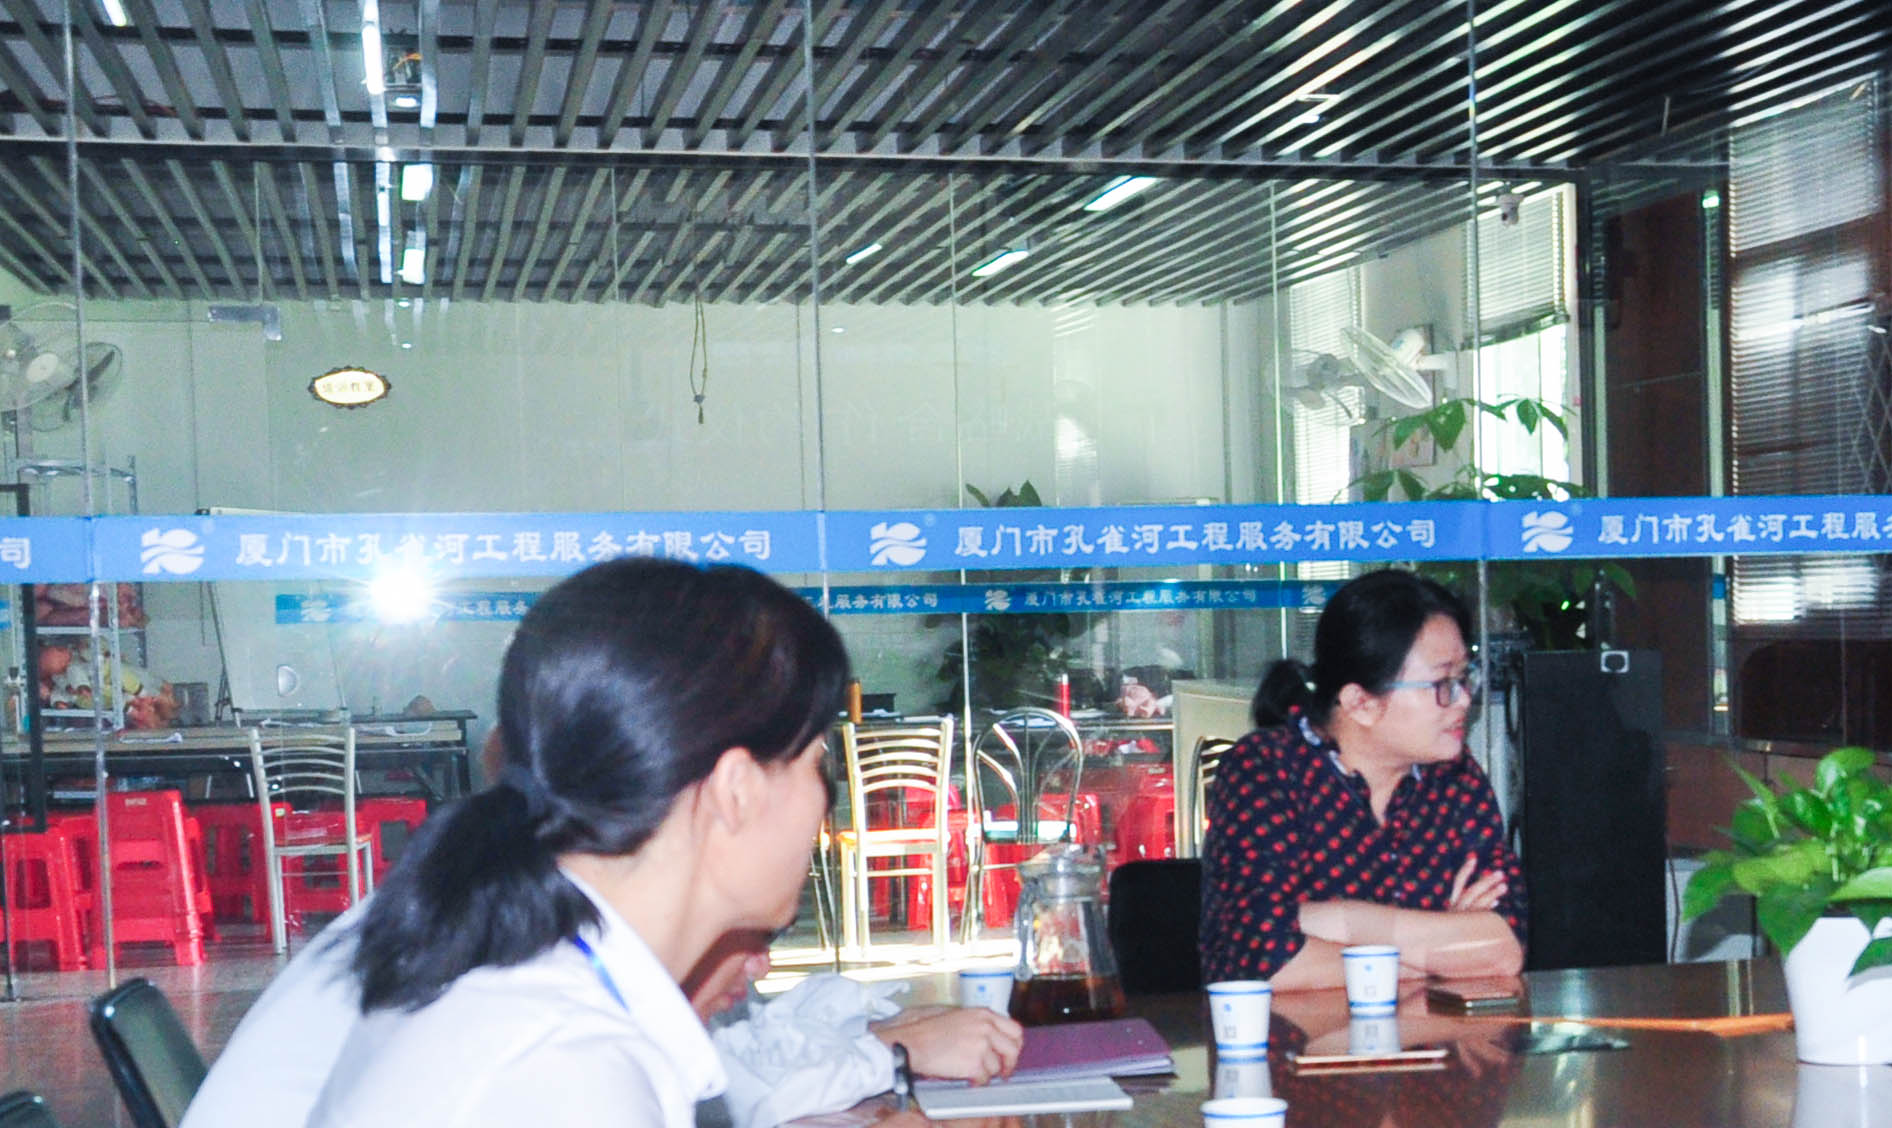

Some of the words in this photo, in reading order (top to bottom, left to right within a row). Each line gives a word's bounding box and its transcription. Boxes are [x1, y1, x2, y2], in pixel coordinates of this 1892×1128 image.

[954, 519, 1436, 557] 厦门市孔雀河工程服务有限公司
